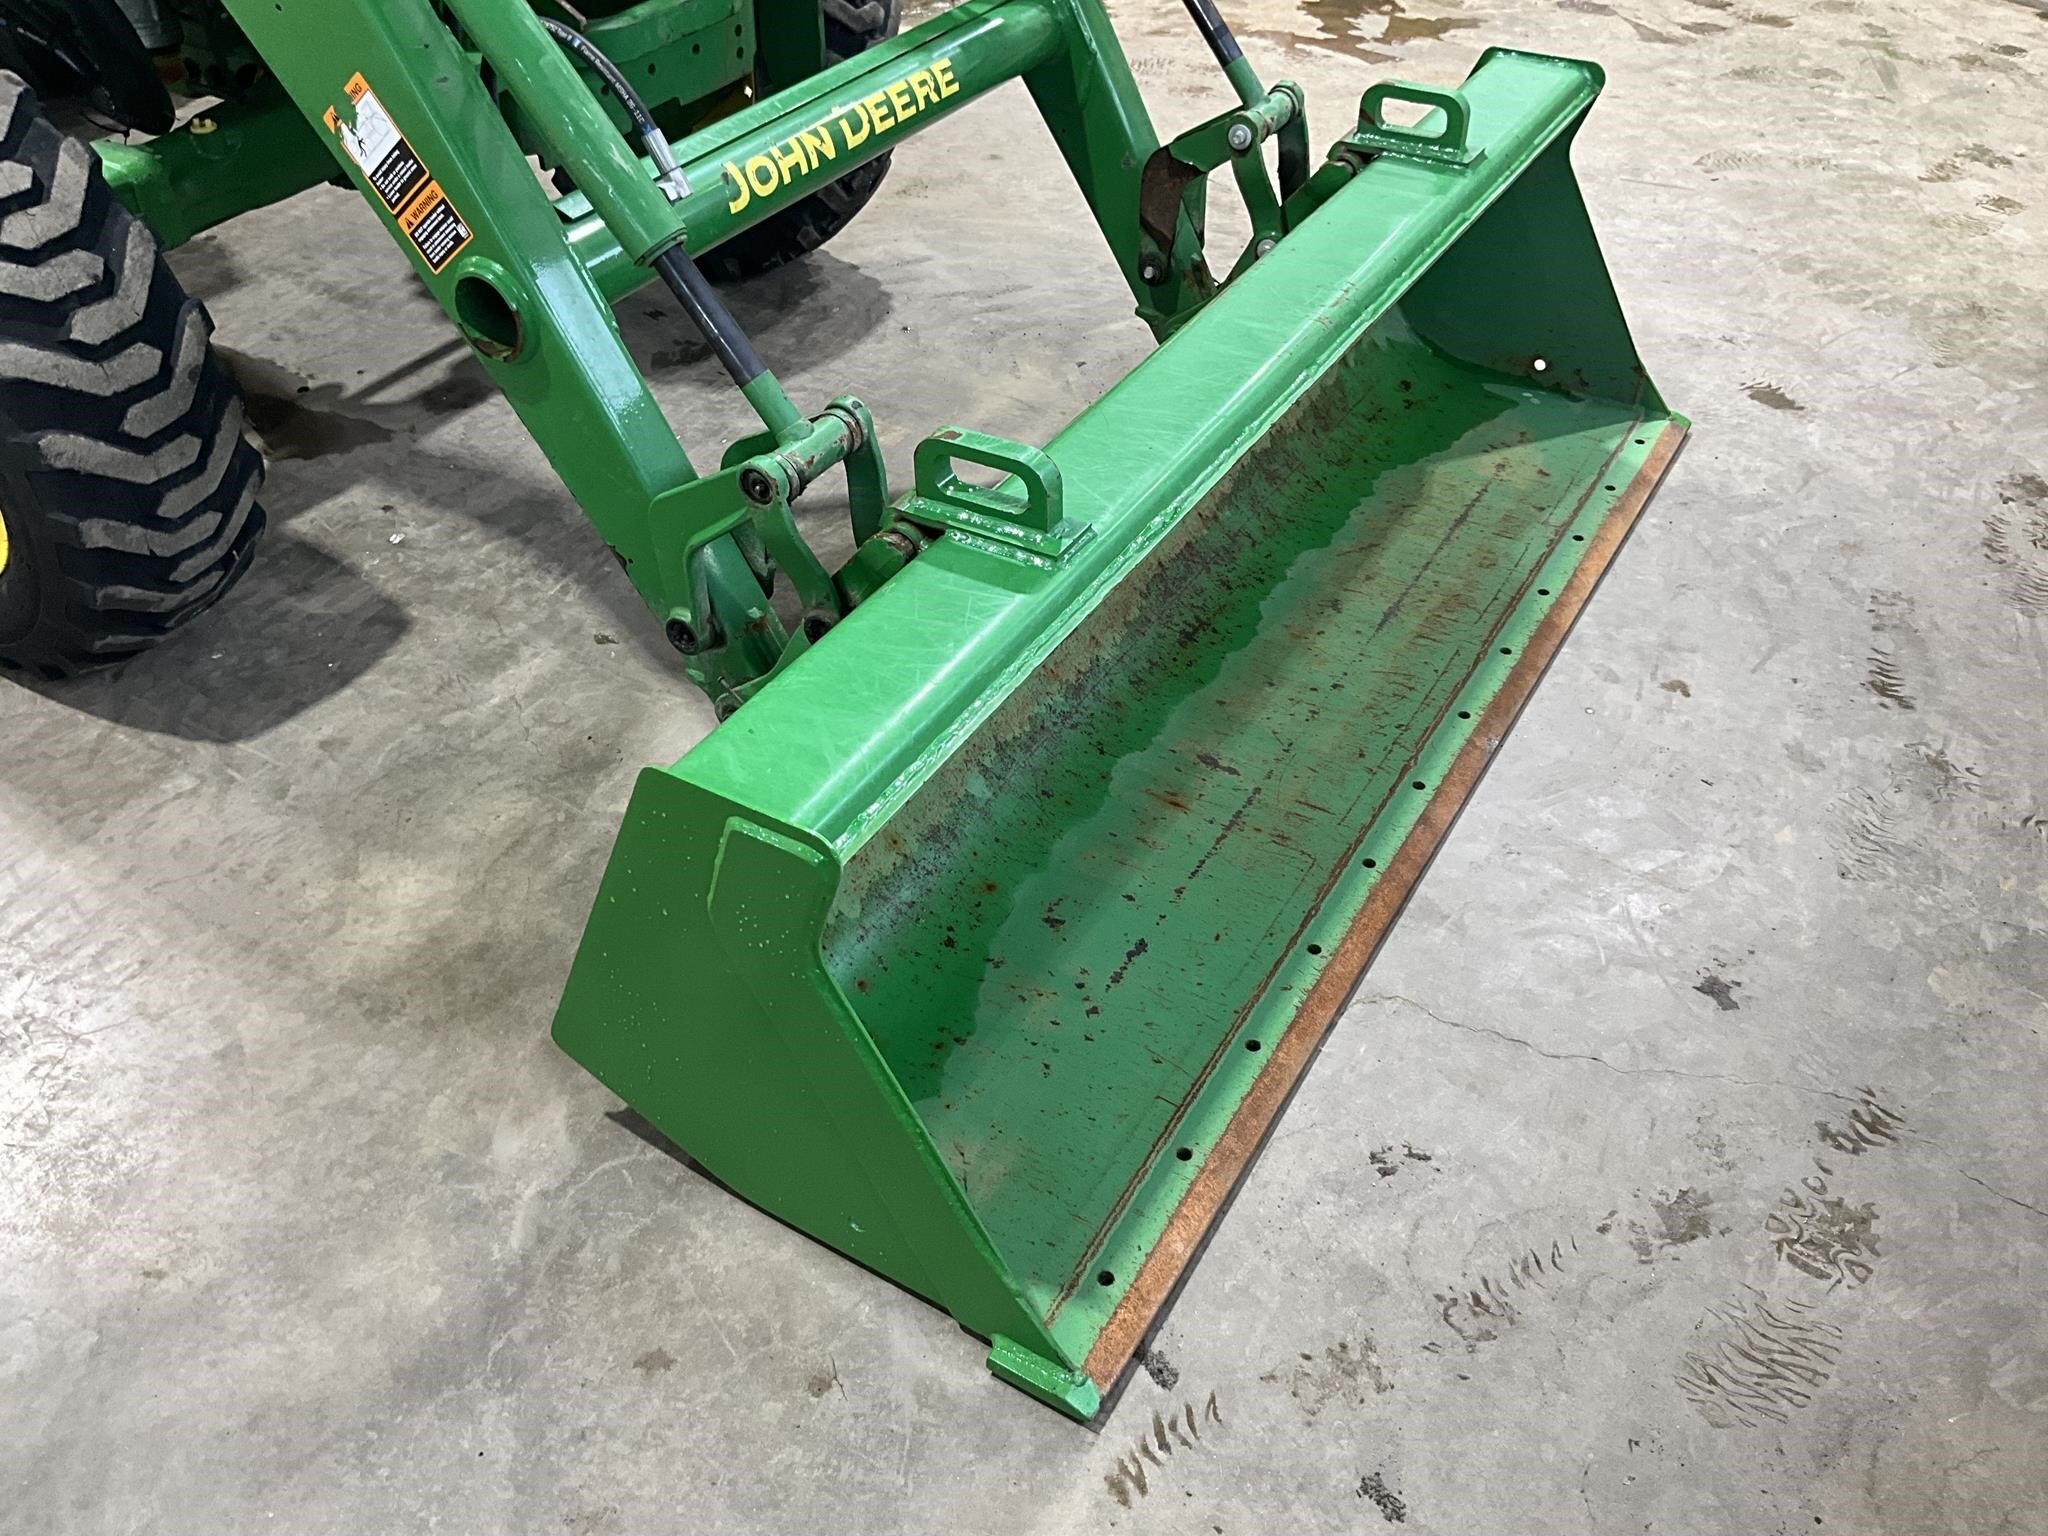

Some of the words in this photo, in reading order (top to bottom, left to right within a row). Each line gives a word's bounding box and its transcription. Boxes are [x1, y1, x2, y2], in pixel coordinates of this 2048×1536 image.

[724, 125, 836, 215] JOHN
[834, 57, 960, 150] DEERE
[412, 190, 439, 221] WARNING
